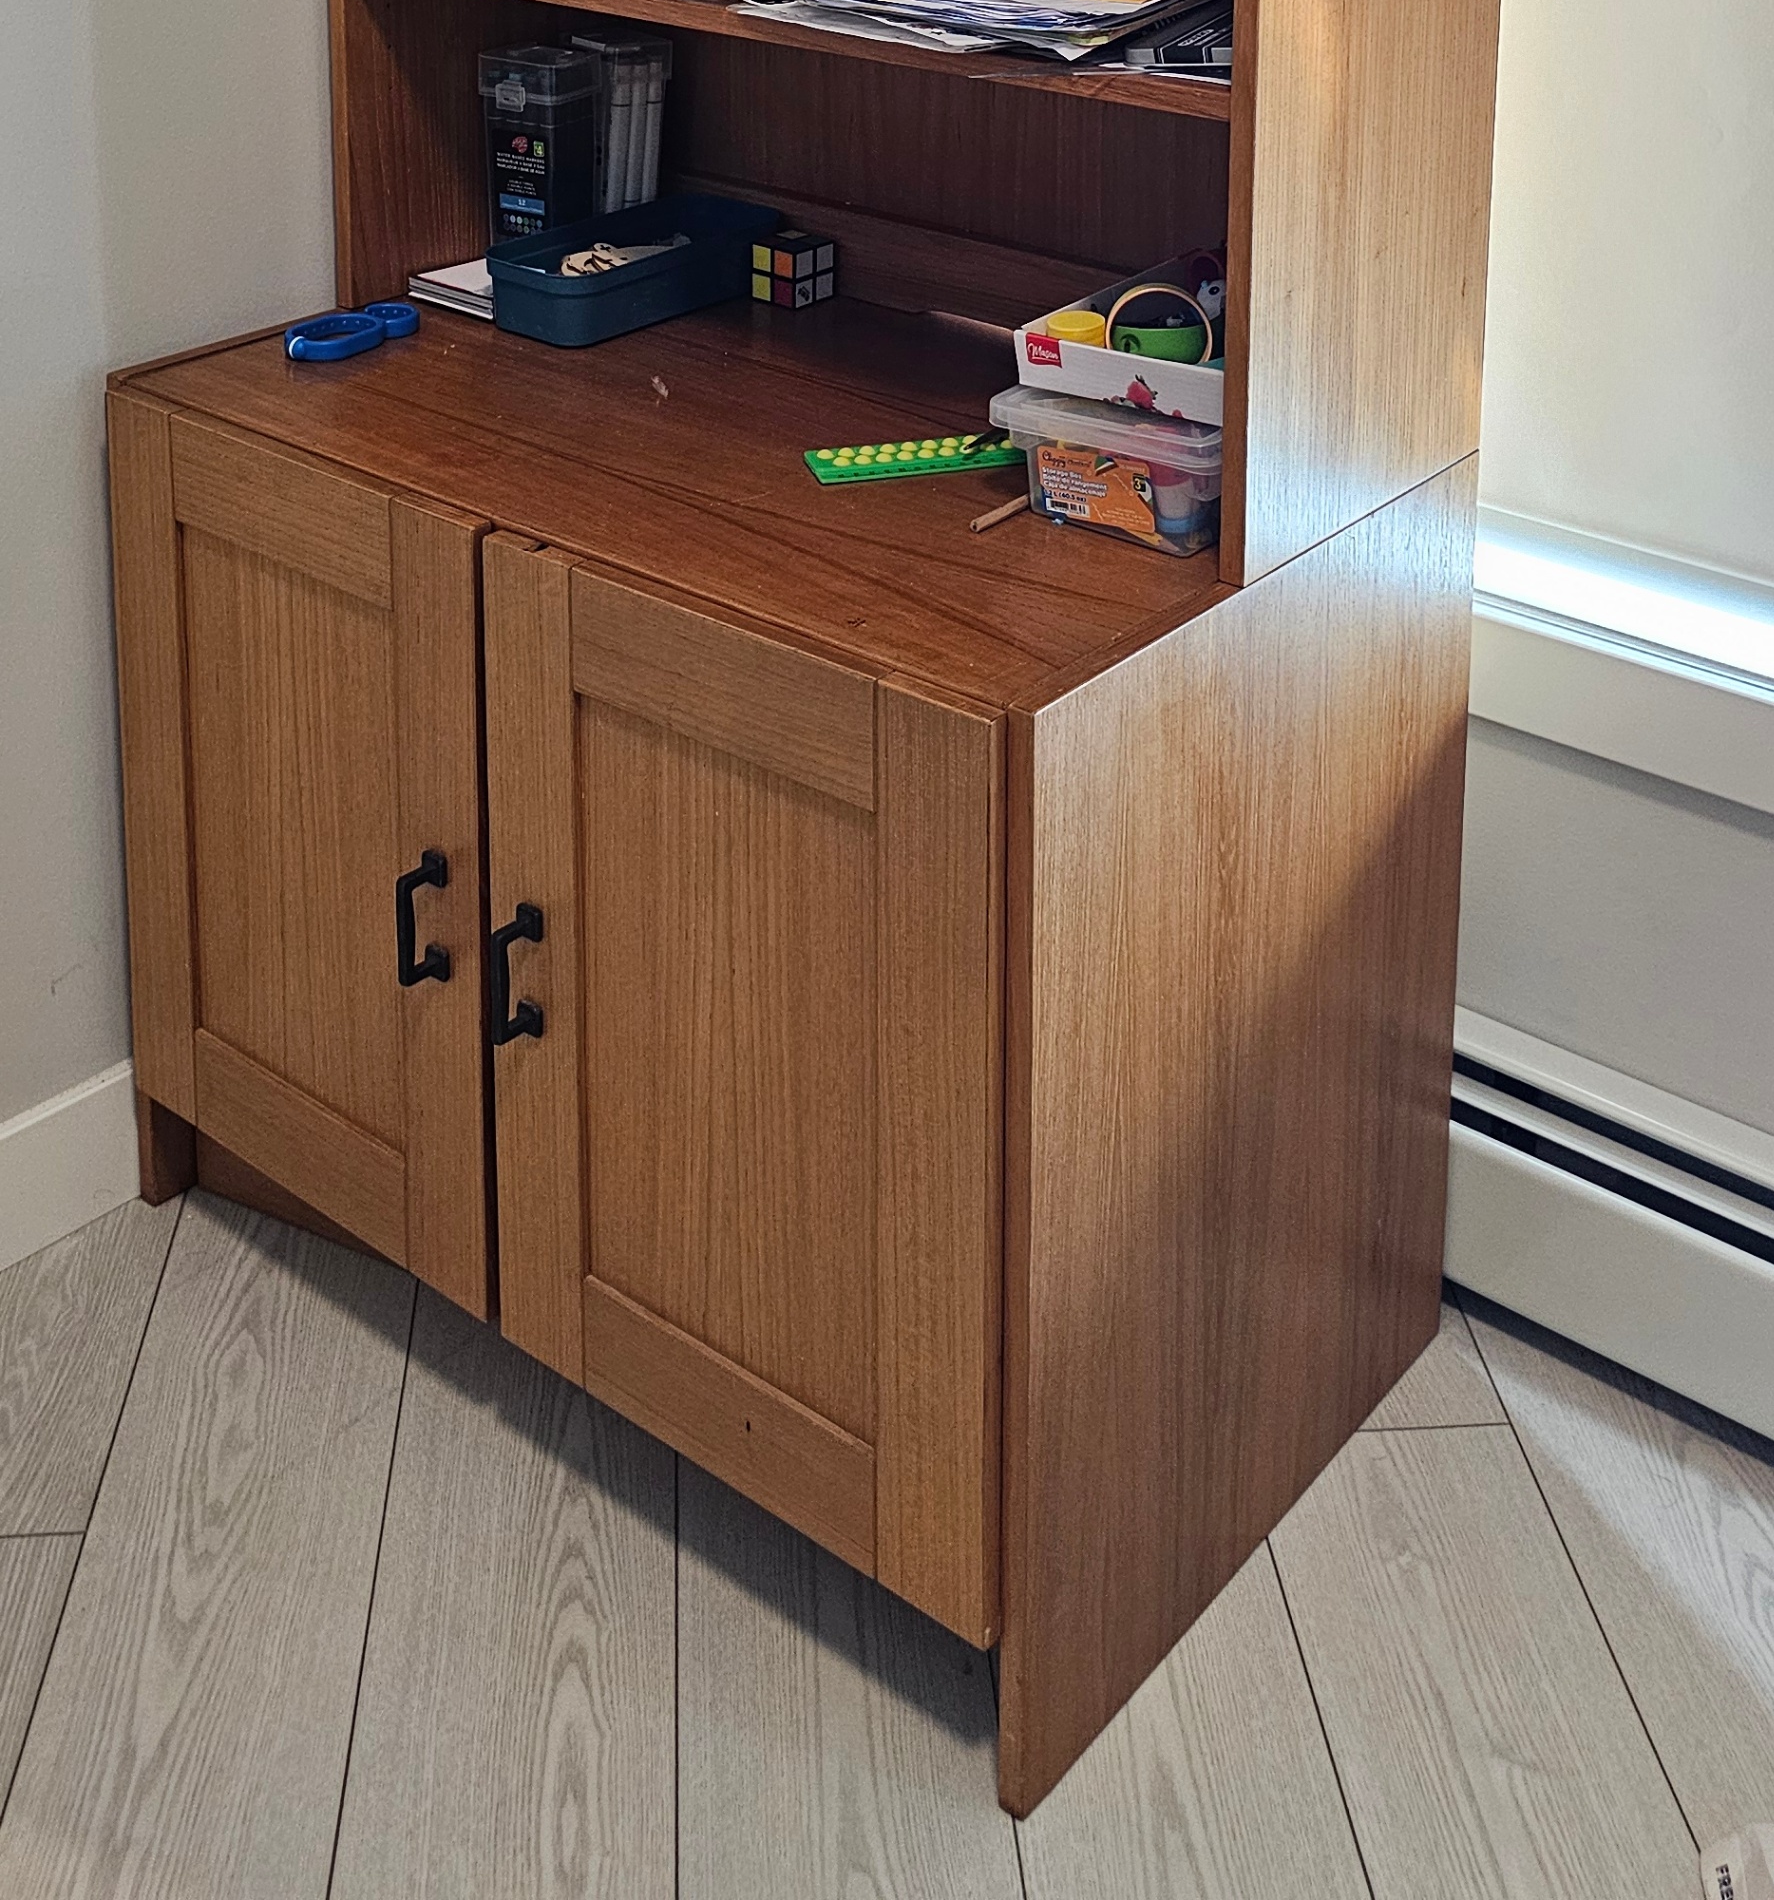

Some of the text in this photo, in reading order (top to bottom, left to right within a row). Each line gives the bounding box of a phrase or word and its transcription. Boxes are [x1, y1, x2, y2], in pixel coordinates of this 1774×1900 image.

[1028, 342, 1059, 360] Mason
[1042, 466, 1082, 480] Storage Box
[1044, 480, 1058, 488] Caja
[1068, 485, 1106, 498] almacenaje
[1071, 479, 1108, 491] rangement
[1134, 477, 1142, 490] 3
